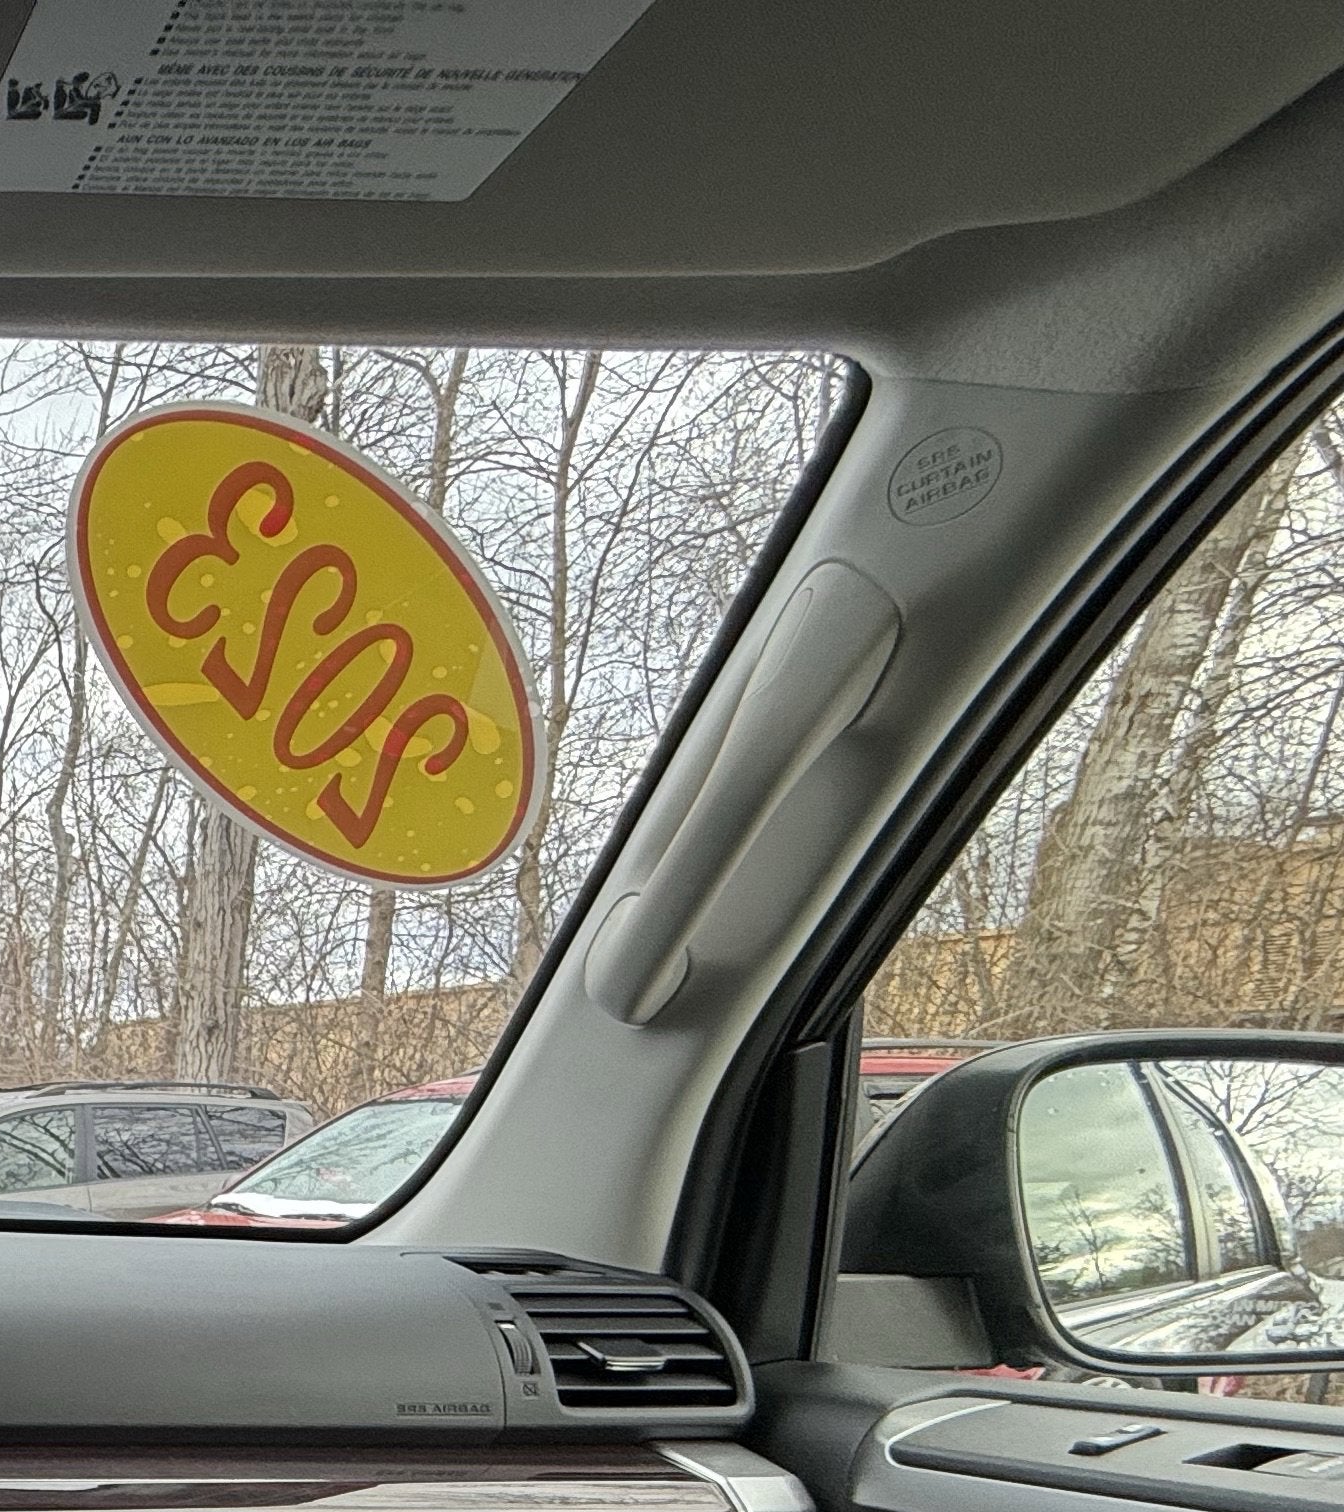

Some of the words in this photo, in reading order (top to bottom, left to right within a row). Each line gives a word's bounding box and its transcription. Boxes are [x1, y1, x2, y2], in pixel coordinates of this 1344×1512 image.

[896, 448, 993, 497] CURTAIN
[917, 444, 960, 471] SRS
[905, 468, 990, 511] AIRBAG
[433, 1403, 491, 1413] AIRBAG
